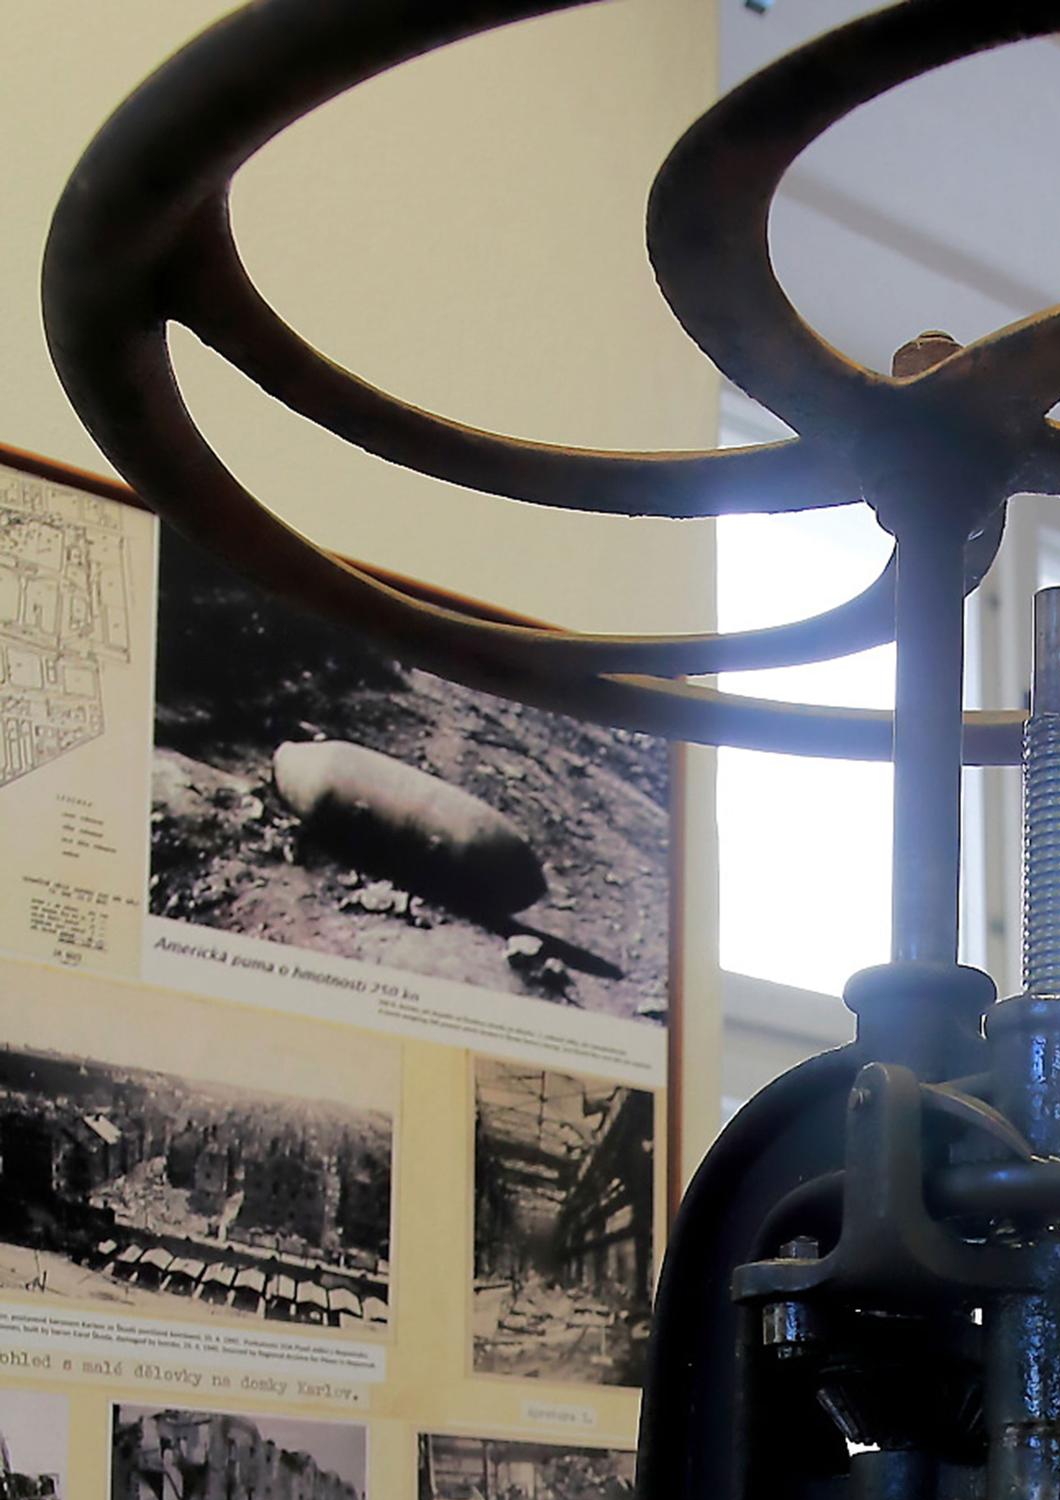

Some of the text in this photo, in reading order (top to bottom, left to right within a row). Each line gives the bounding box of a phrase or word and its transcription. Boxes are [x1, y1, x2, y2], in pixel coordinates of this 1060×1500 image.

[154, 936, 227, 964] Americká
[232, 955, 275, 974] puma
[279, 964, 289, 976] o
[292, 966, 366, 993] hmotnosti
[82, 1361, 122, 1376] malé
[134, 1368, 202, 1387] dělovky
[212, 1376, 231, 1387] na
